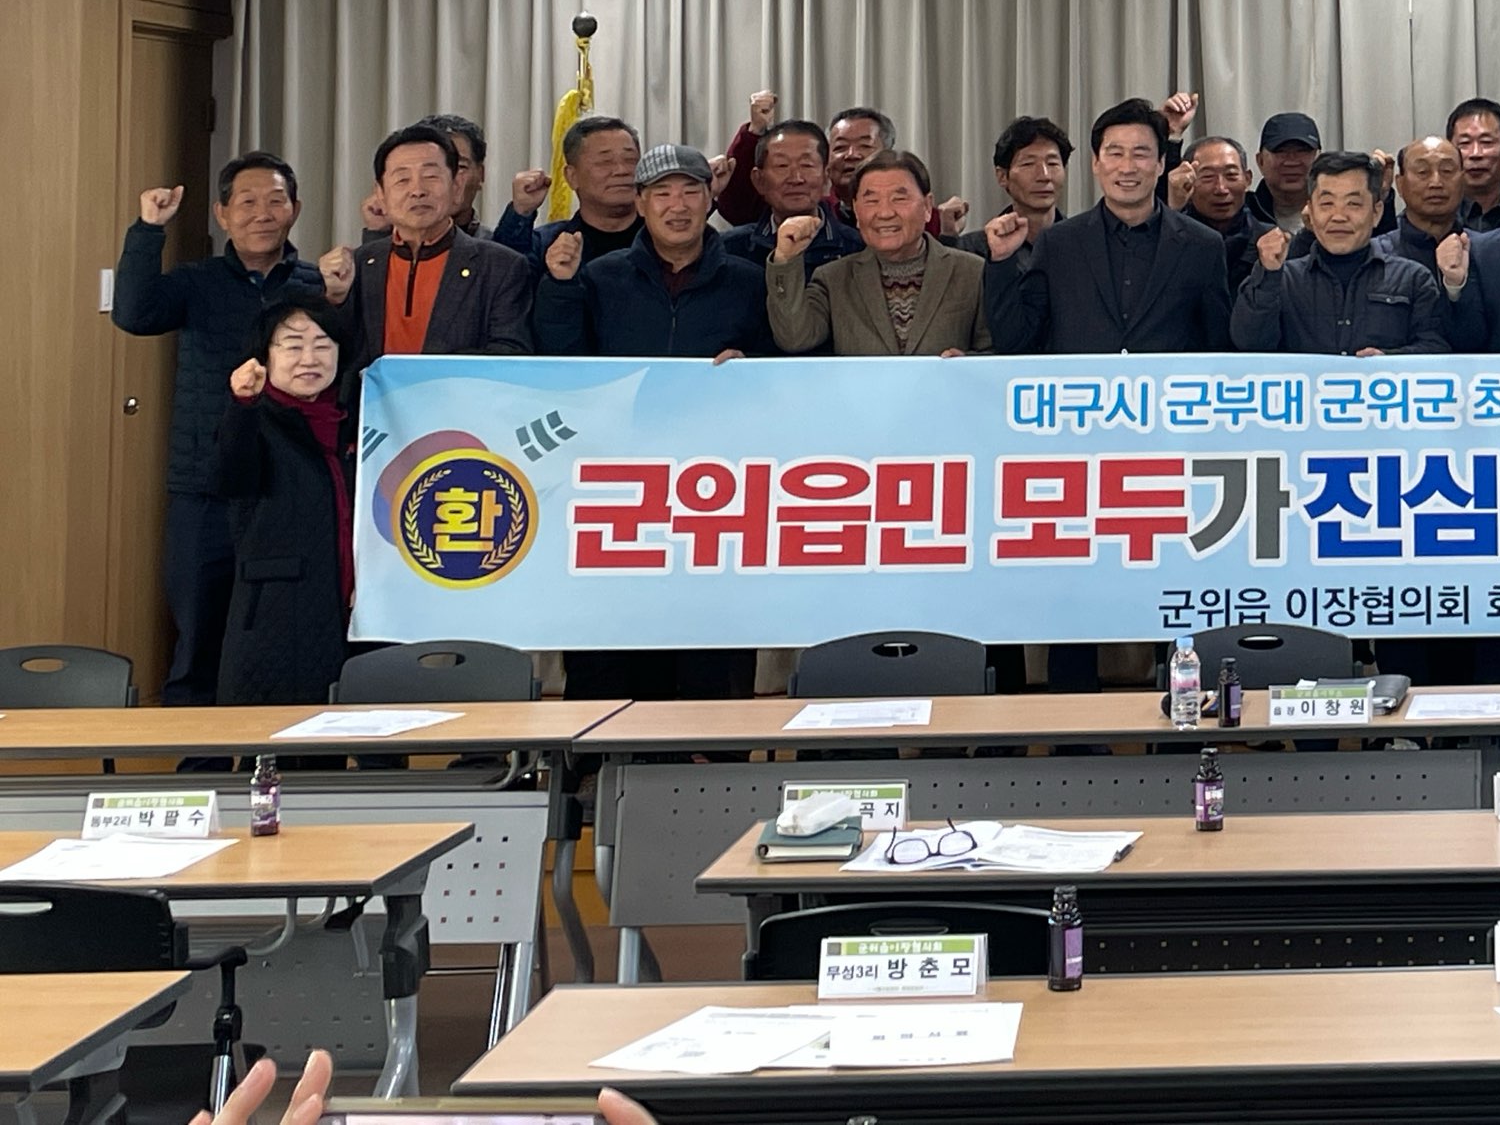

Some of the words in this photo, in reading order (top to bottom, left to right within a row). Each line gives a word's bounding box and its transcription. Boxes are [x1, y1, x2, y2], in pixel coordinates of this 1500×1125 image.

[1013, 380, 1149, 428] 대구시
[1166, 379, 1303, 425] 군부대
[1320, 378, 1457, 424] 군위군
[433, 487, 503, 553] 환
[573, 461, 968, 569] 군위읍민
[996, 456, 1290, 562] 모두가
[1158, 587, 1271, 628] 군위읍
[1285, 585, 1471, 625] 이장협의회
